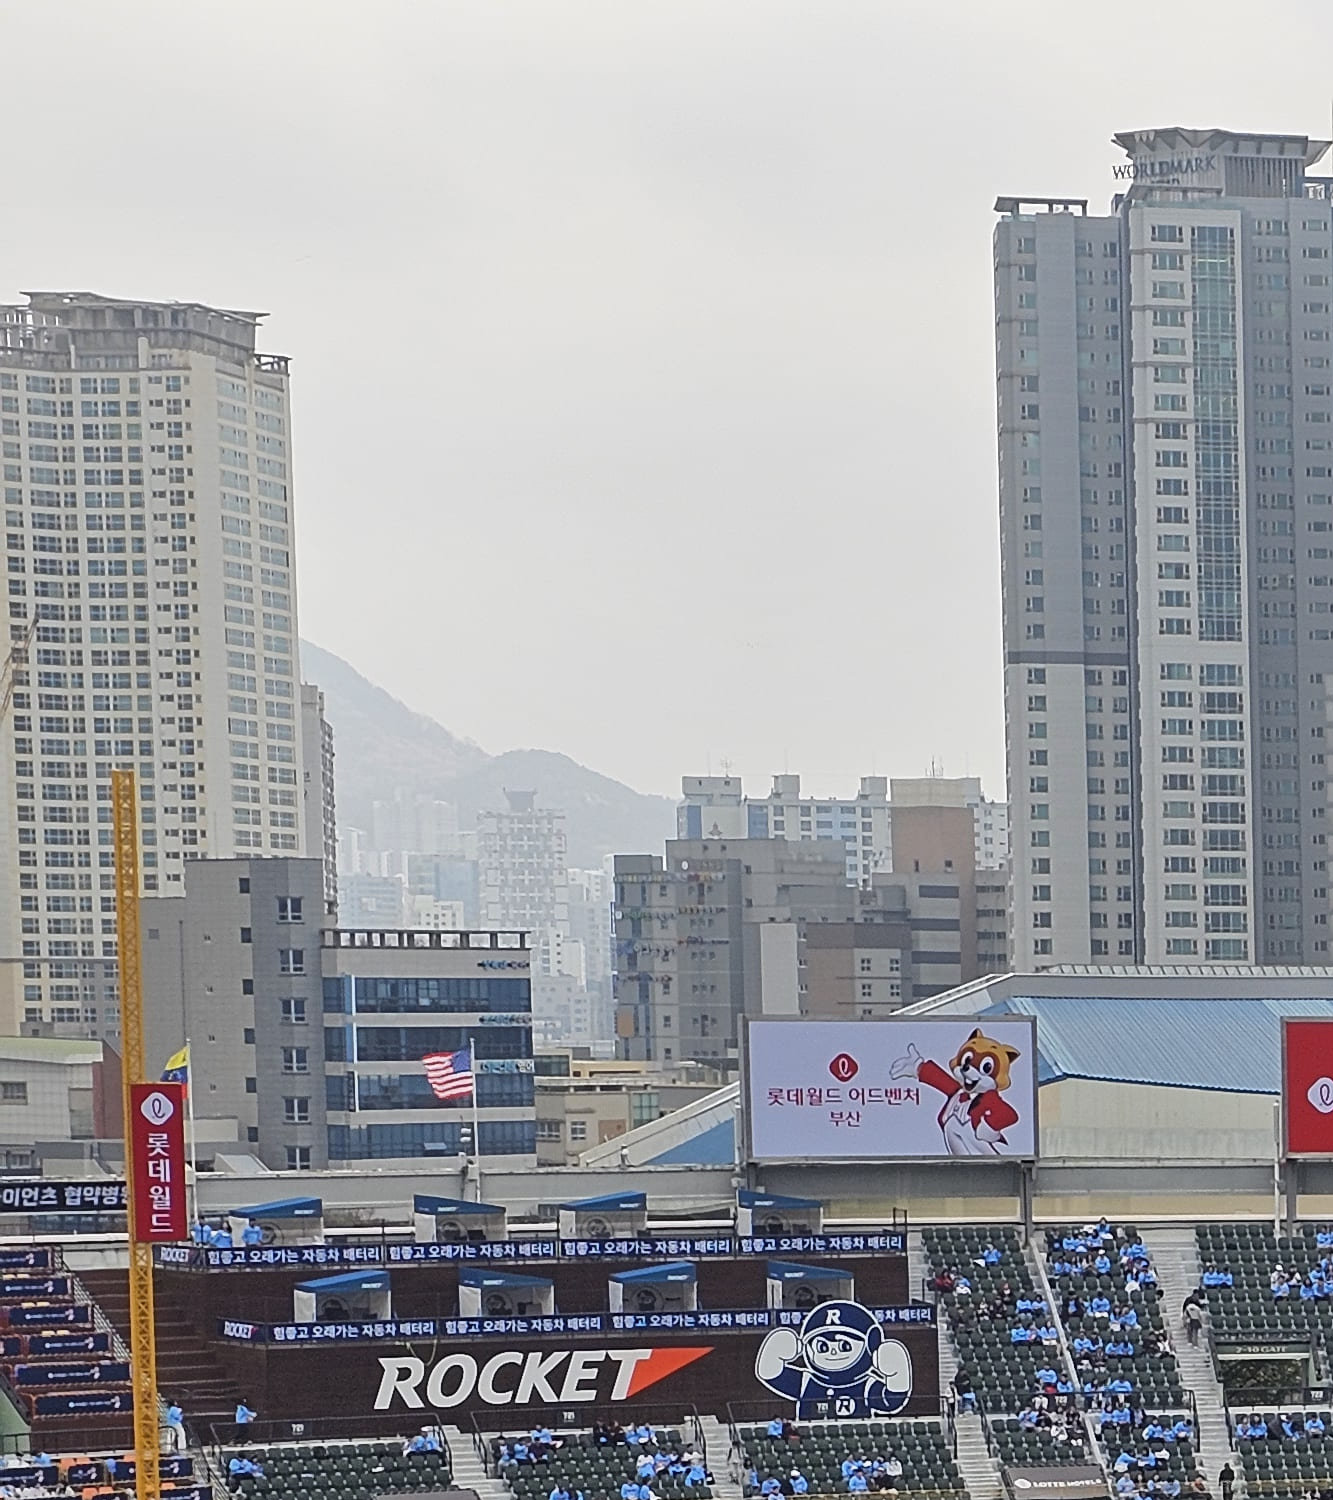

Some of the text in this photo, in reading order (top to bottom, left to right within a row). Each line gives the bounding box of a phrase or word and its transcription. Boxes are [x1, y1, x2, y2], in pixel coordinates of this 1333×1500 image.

[1112, 155, 1216, 179] WORLDMARK
[767, 1087, 921, 1107] 롯데월드 어드벤처
[829, 1112, 862, 1128] 부산
[146, 1133, 174, 1234] 롯데월드
[0, 1185, 58, 1207] 이언츠
[779, 1237, 825, 1251] 오래가는
[828, 1236, 864, 1250] 자동차
[867, 1236, 902, 1249] 배터리
[249, 1249, 298, 1264] 오래가는
[302, 1248, 339, 1263] 자동차
[343, 1247, 380, 1261] 배터리
[825, 1309, 842, 1325] R
[373, 1348, 653, 1410] ROCKET
